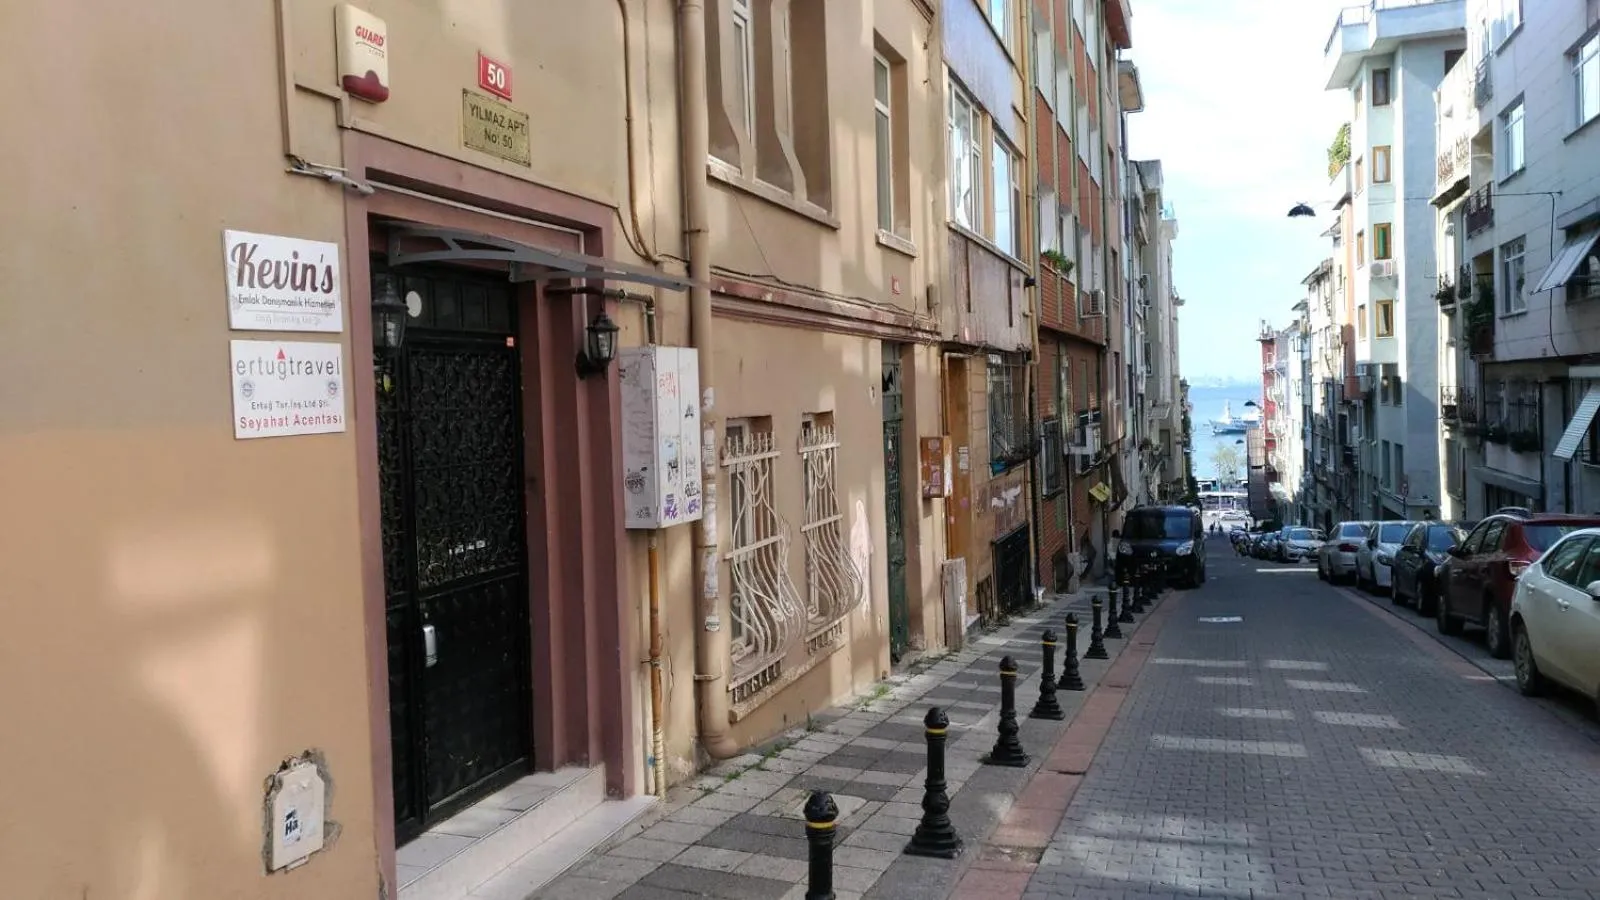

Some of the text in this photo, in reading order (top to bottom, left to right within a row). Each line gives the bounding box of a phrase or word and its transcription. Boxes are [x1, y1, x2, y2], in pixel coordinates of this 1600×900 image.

[355, 25, 384, 47] GUARD
[487, 63, 505, 90] 50
[469, 103, 505, 128] YILMAZ
[501, 134, 513, 149] 50
[231, 242, 334, 294] Kevin's
[238, 293, 260, 305] Emlak
[240, 413, 342, 431] Seyahat Acentası
